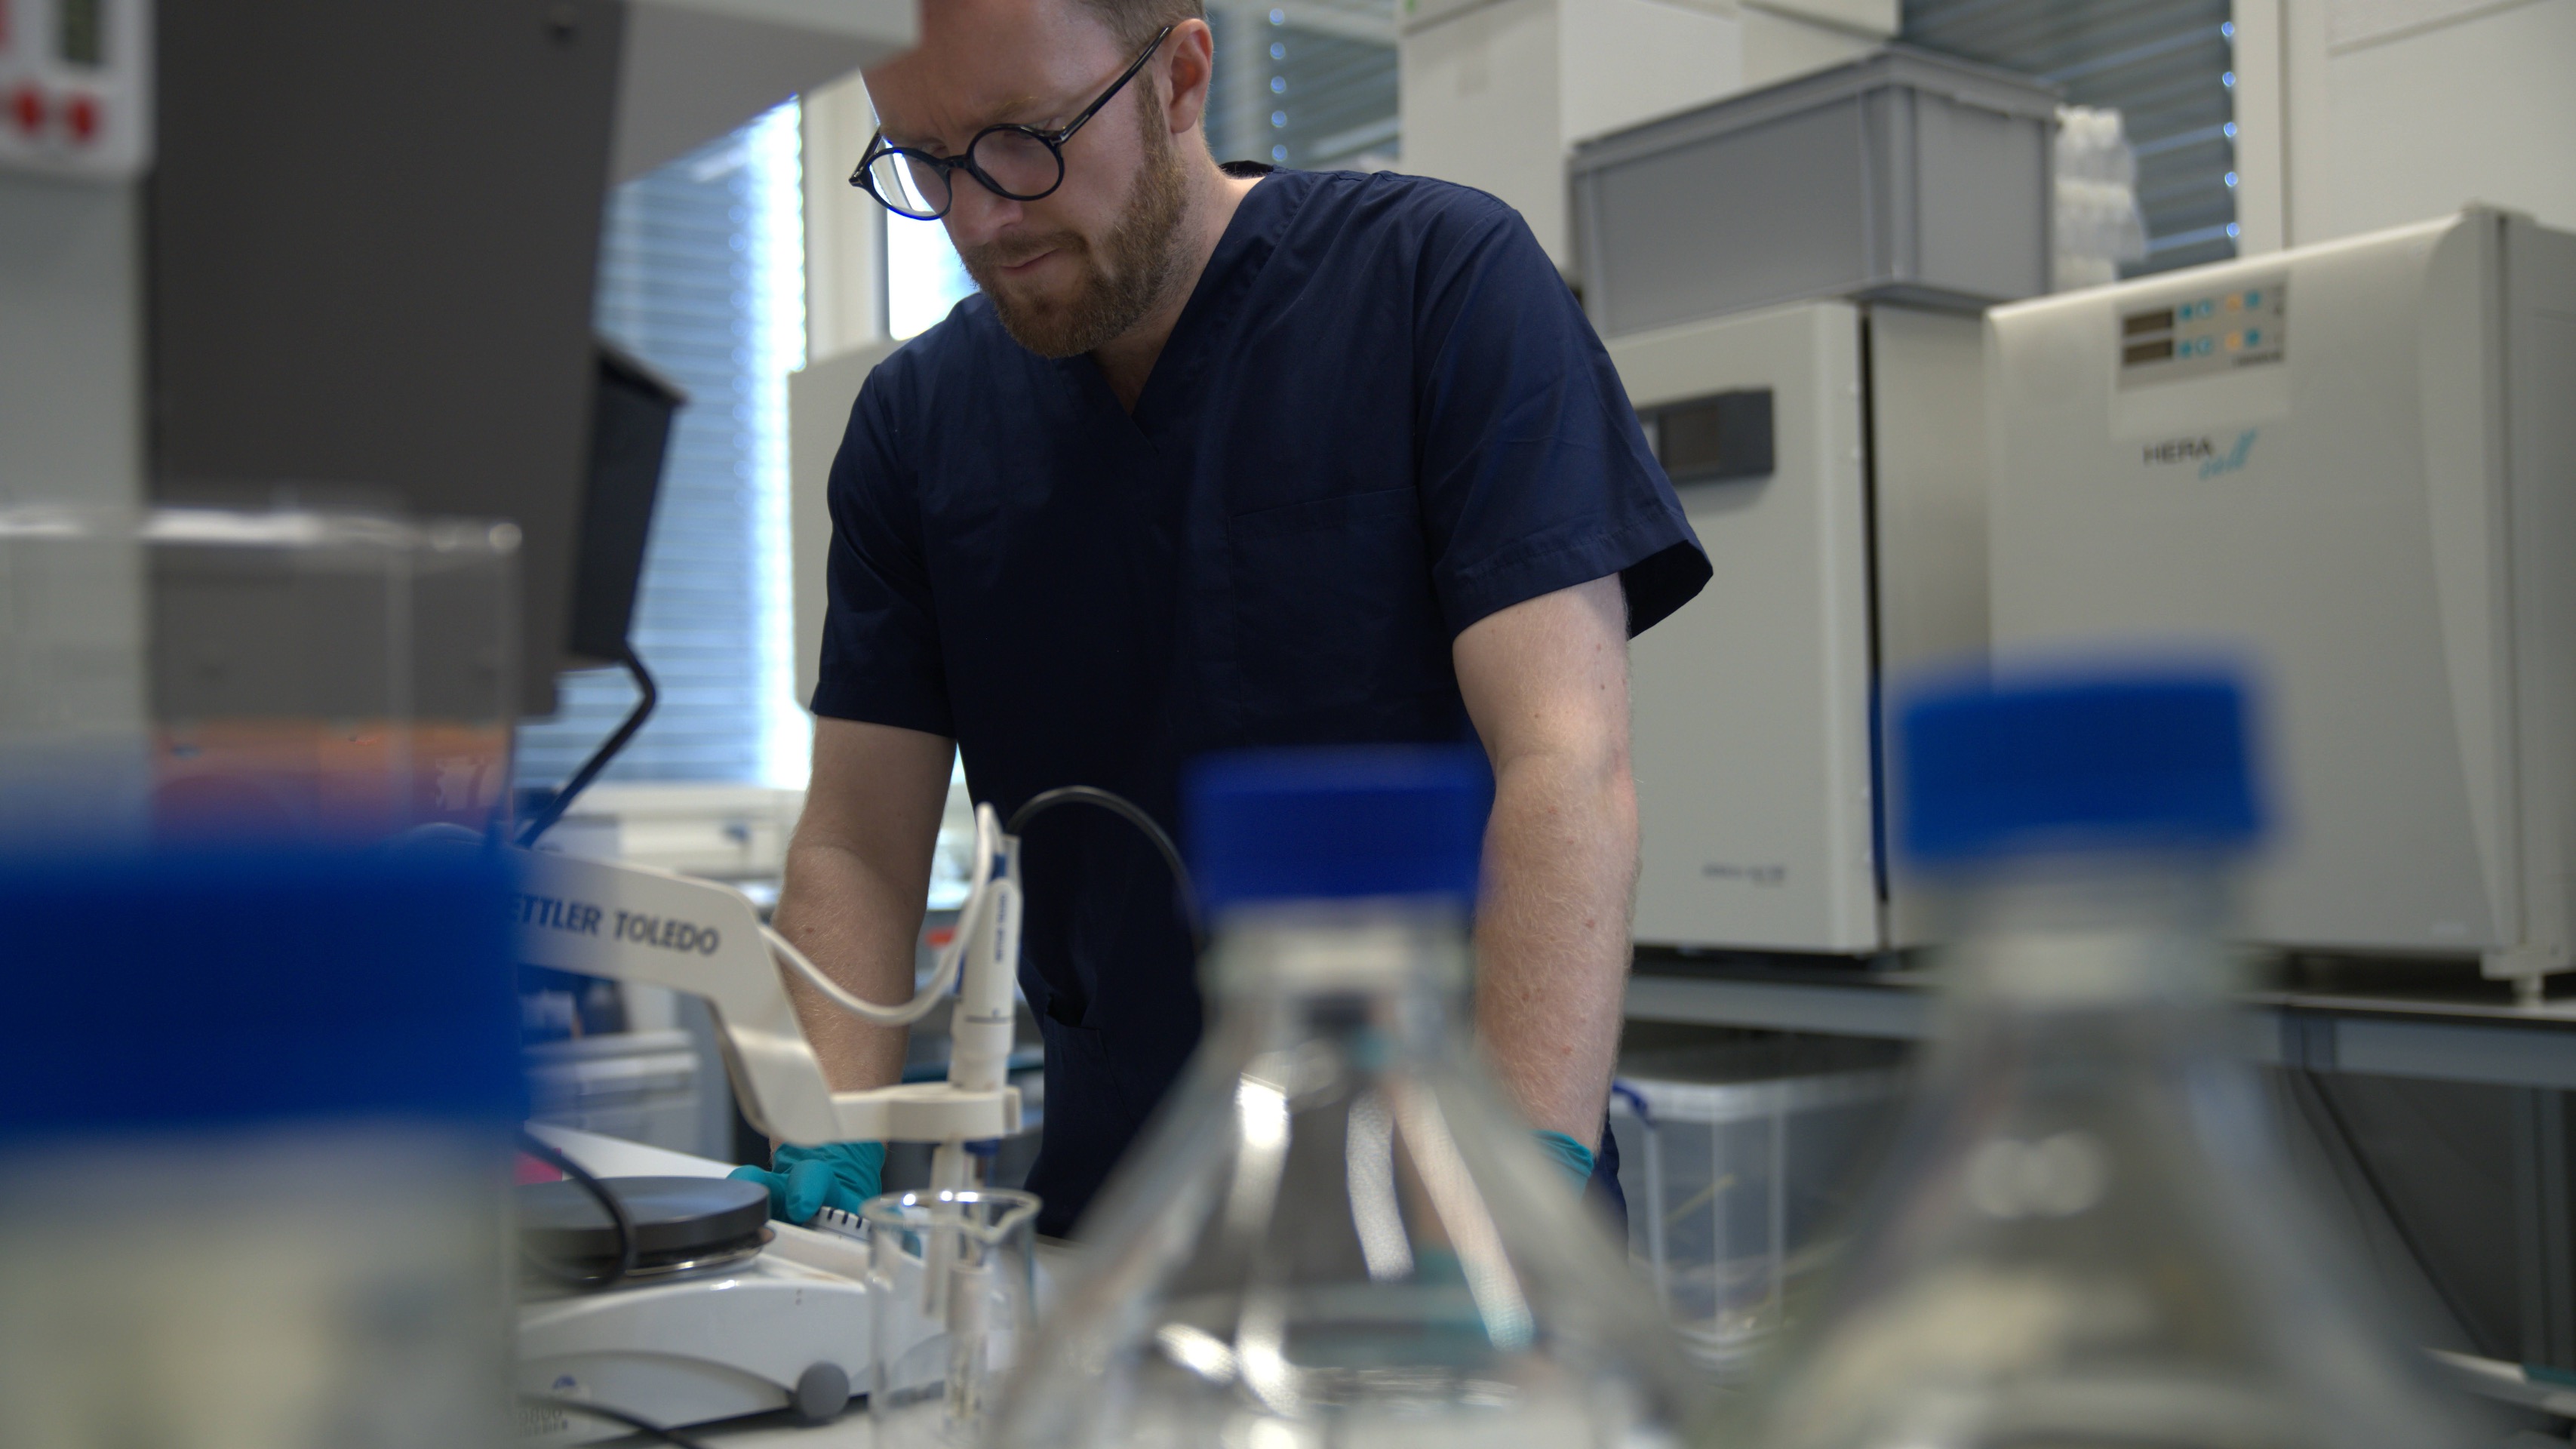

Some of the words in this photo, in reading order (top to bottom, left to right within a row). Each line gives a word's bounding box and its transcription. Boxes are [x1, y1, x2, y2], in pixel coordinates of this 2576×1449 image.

[2143, 436, 2215, 466] HERA
[510, 893, 601, 937] ETTLER
[613, 910, 720, 956] TOLEDO
